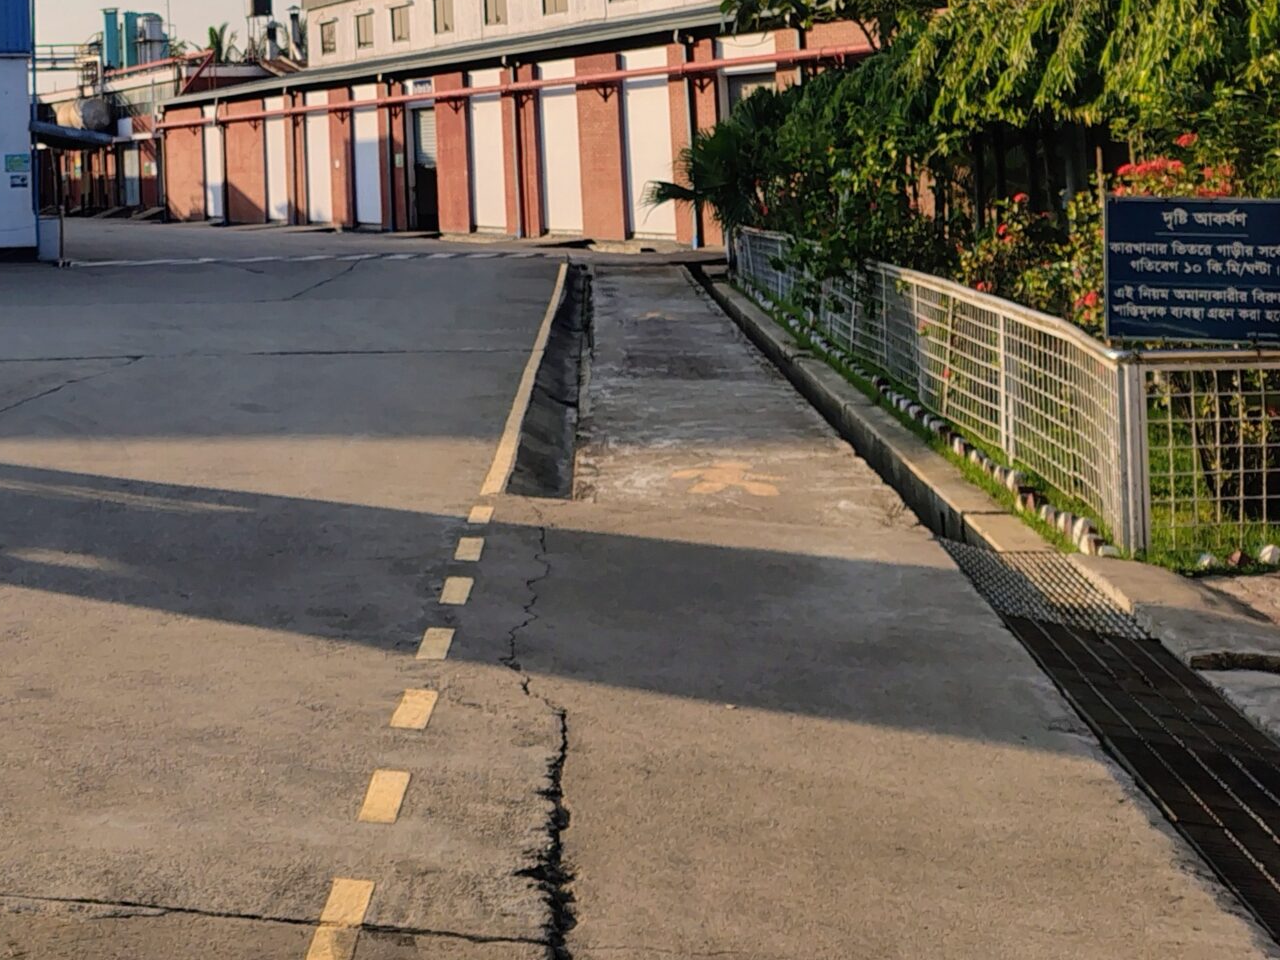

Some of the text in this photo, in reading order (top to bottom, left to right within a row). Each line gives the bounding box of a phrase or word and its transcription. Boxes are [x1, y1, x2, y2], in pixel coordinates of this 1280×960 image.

[1162, 207, 1247, 230] দৃষ্টি আকর্ষণ
[1110, 242, 1167, 256] কারখানার
[1130, 257, 1179, 274] গতিবেগ
[1184, 262, 1202, 274] ১০
[1114, 285, 1134, 301] এই
[1238, 308, 1261, 321] করা
